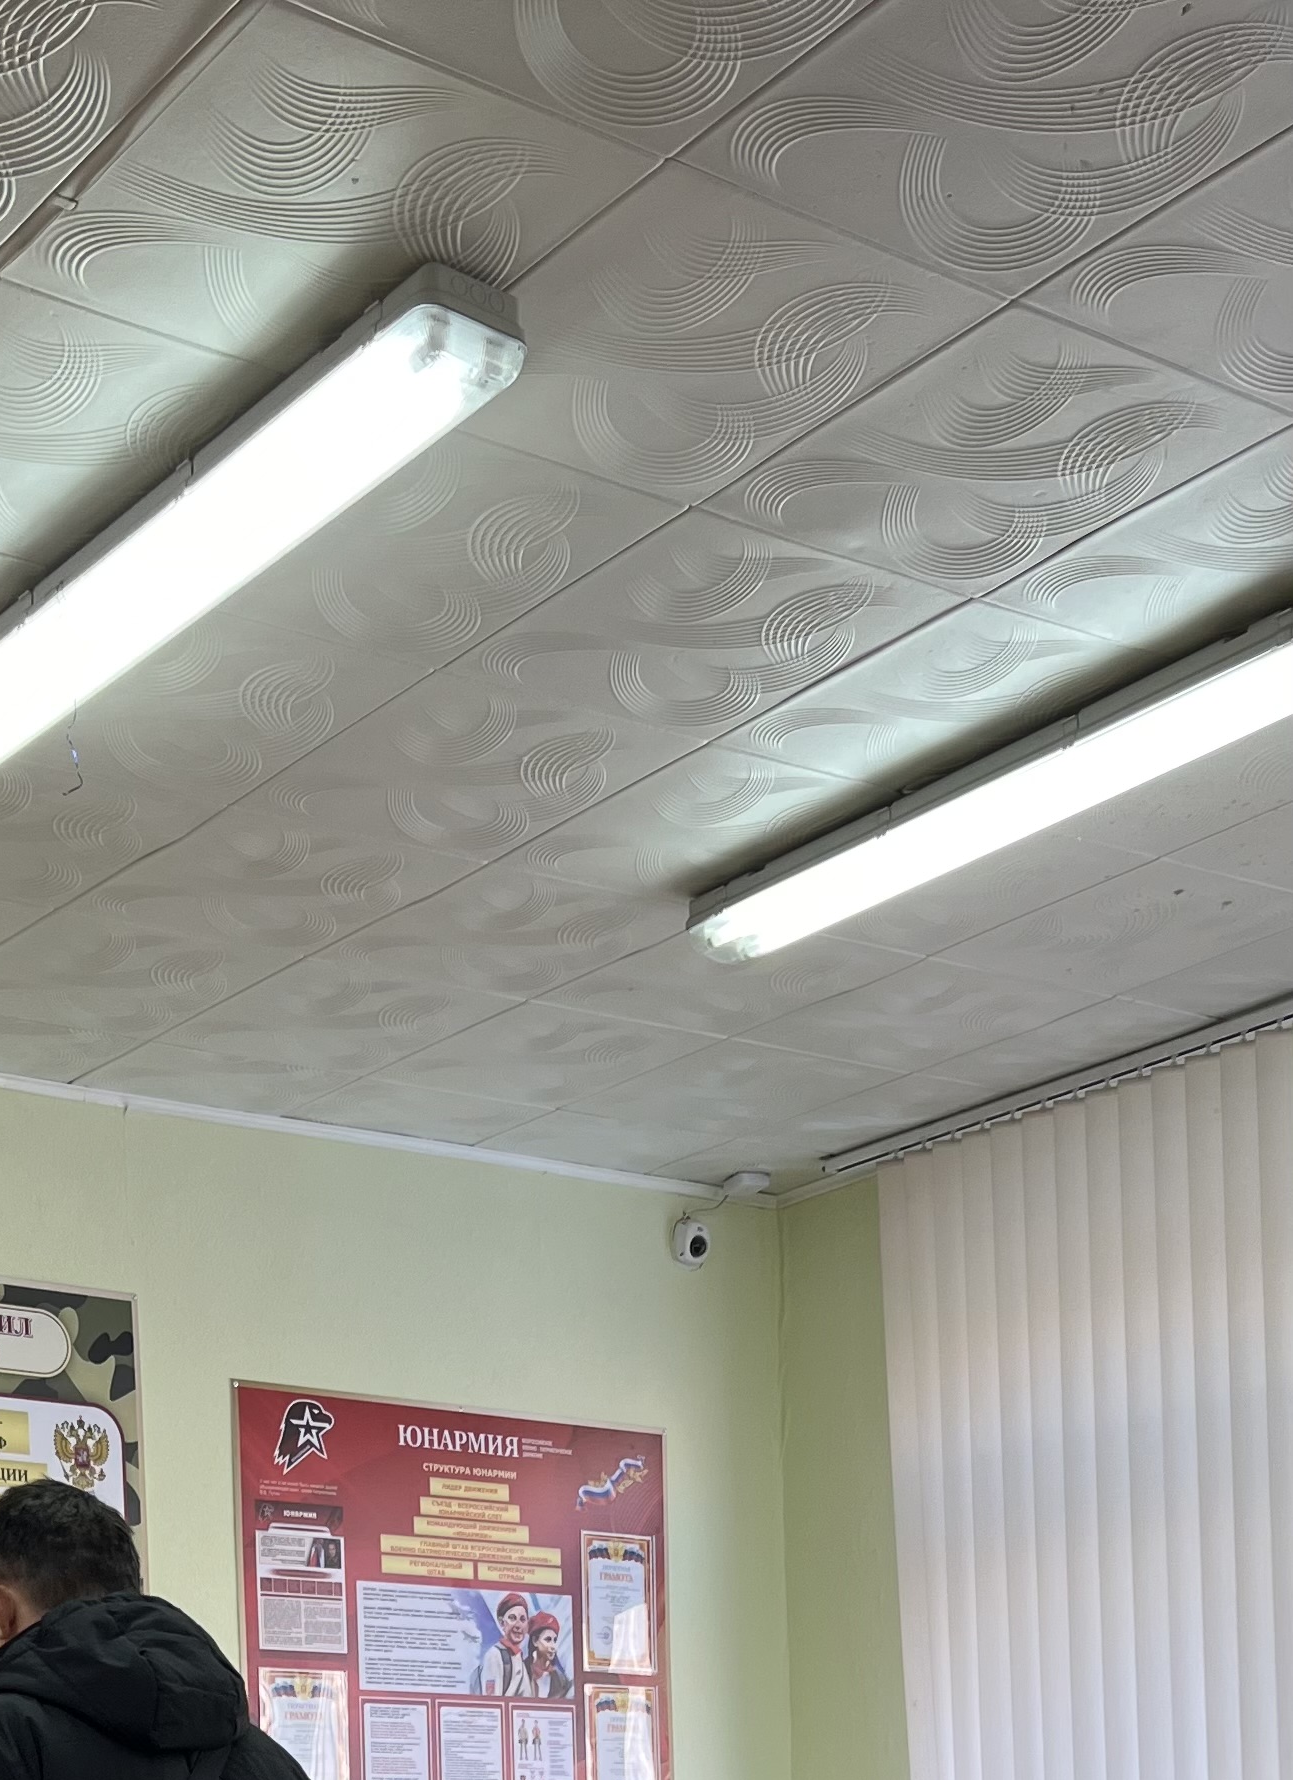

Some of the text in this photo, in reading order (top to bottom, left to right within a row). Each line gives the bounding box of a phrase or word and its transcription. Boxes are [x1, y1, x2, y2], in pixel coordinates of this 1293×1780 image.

[397, 1424, 519, 1458] ЮНАРМИЯ
[423, 1462, 517, 1480] СТРУКТУРА ЮНАРМИИ
